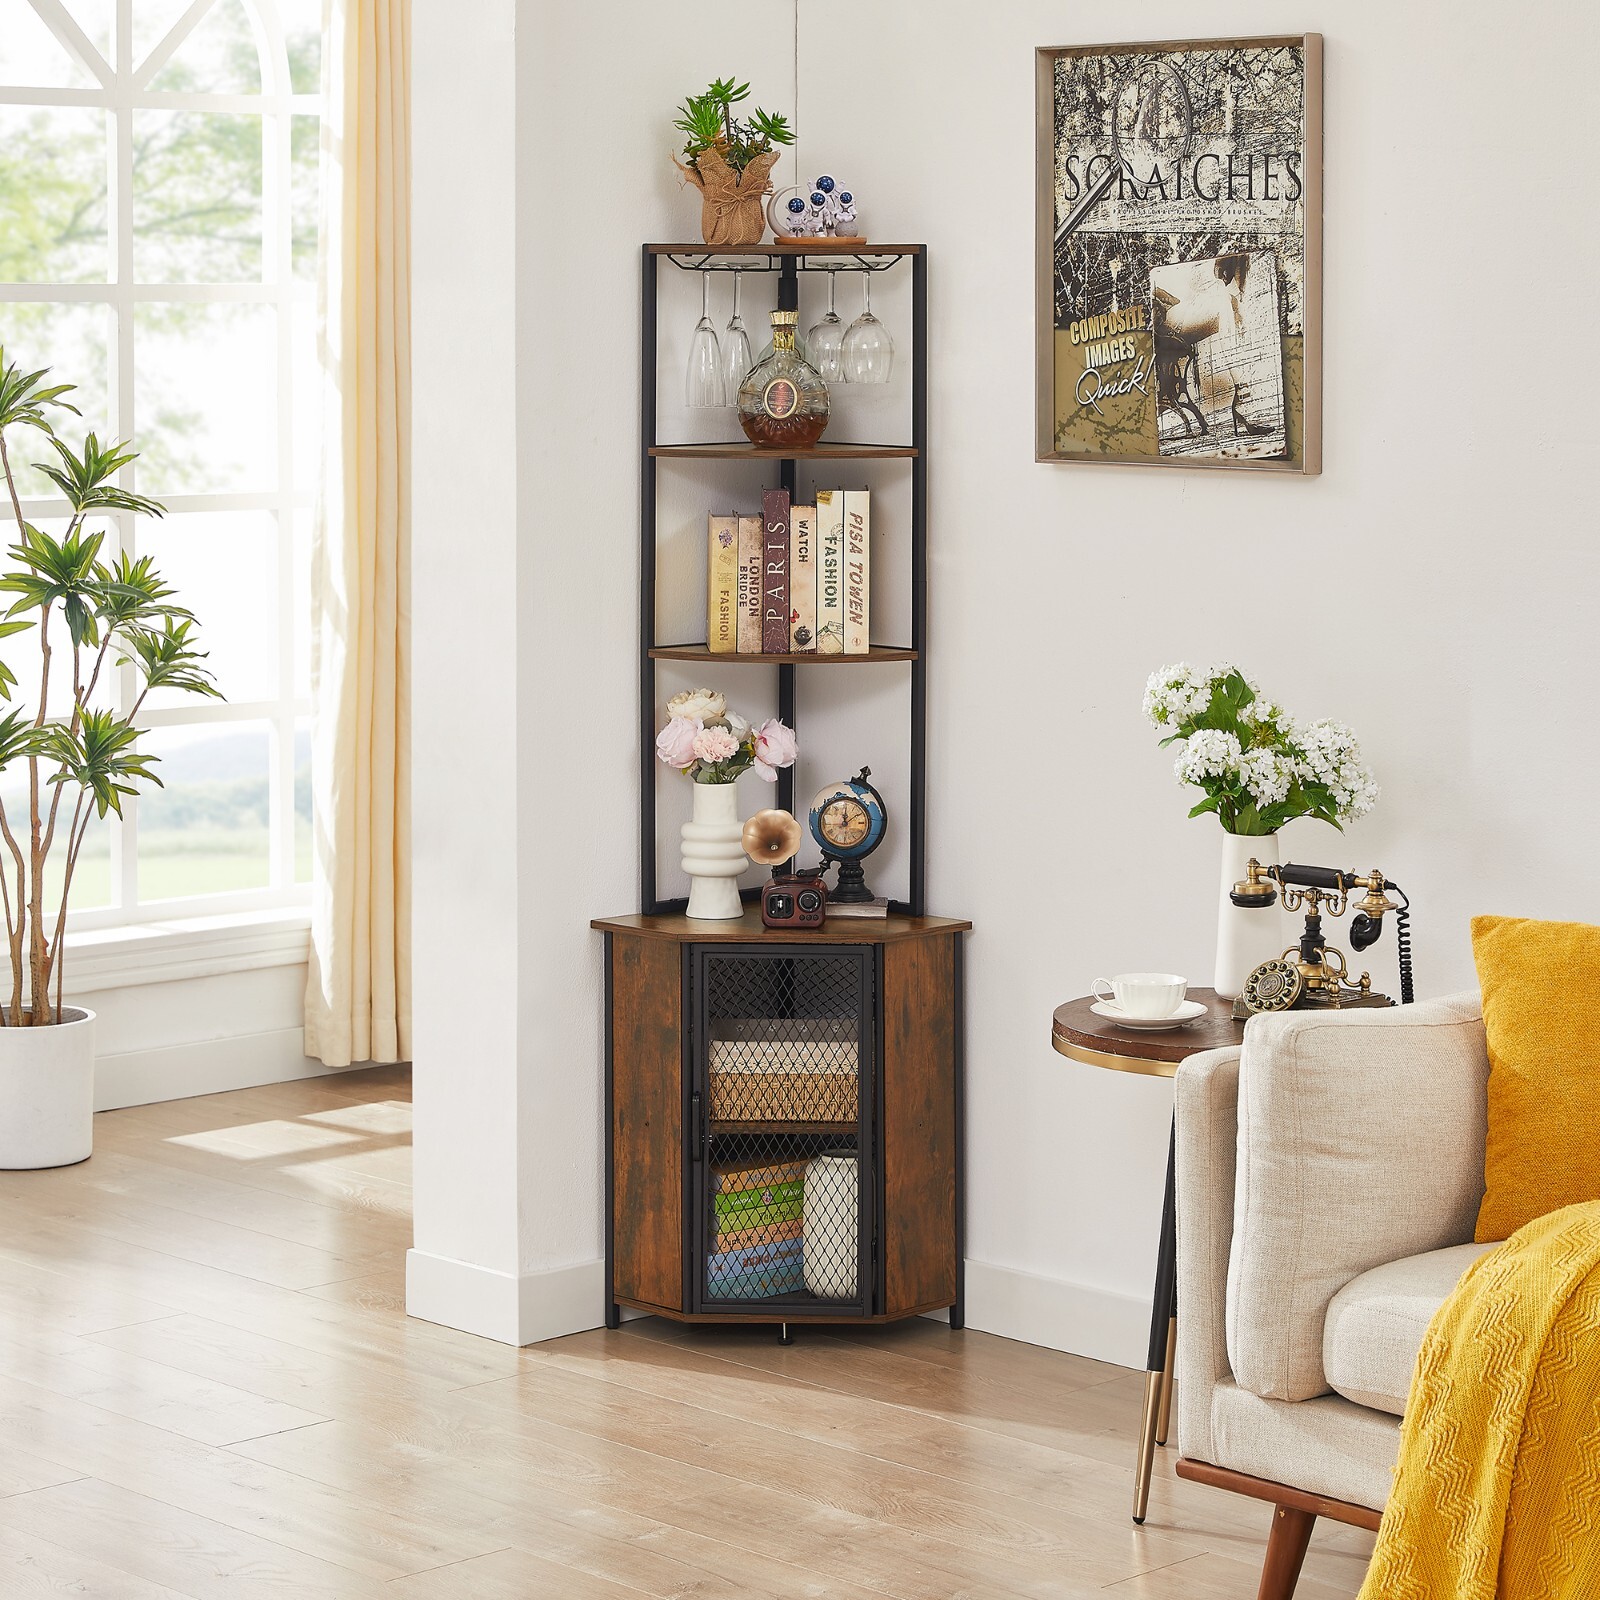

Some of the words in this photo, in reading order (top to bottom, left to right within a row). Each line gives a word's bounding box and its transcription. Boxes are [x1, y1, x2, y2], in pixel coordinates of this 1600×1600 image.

[1064, 153, 1302, 201] SCRATCHES
[1069, 305, 1146, 345] COMPOSITE
[1085, 336, 1136, 368] IMAGES
[1075, 353, 1156, 415] Quick!
[798, 520, 809, 563] WATCH
[849, 511, 863, 555] PISA
[739, 565, 748, 608] BRIDGE
[749, 556, 760, 617] LONDON
[766, 522, 786, 622] PARIS
[824, 536, 838, 608] FASHION
[719, 590, 730, 641] FASHION
